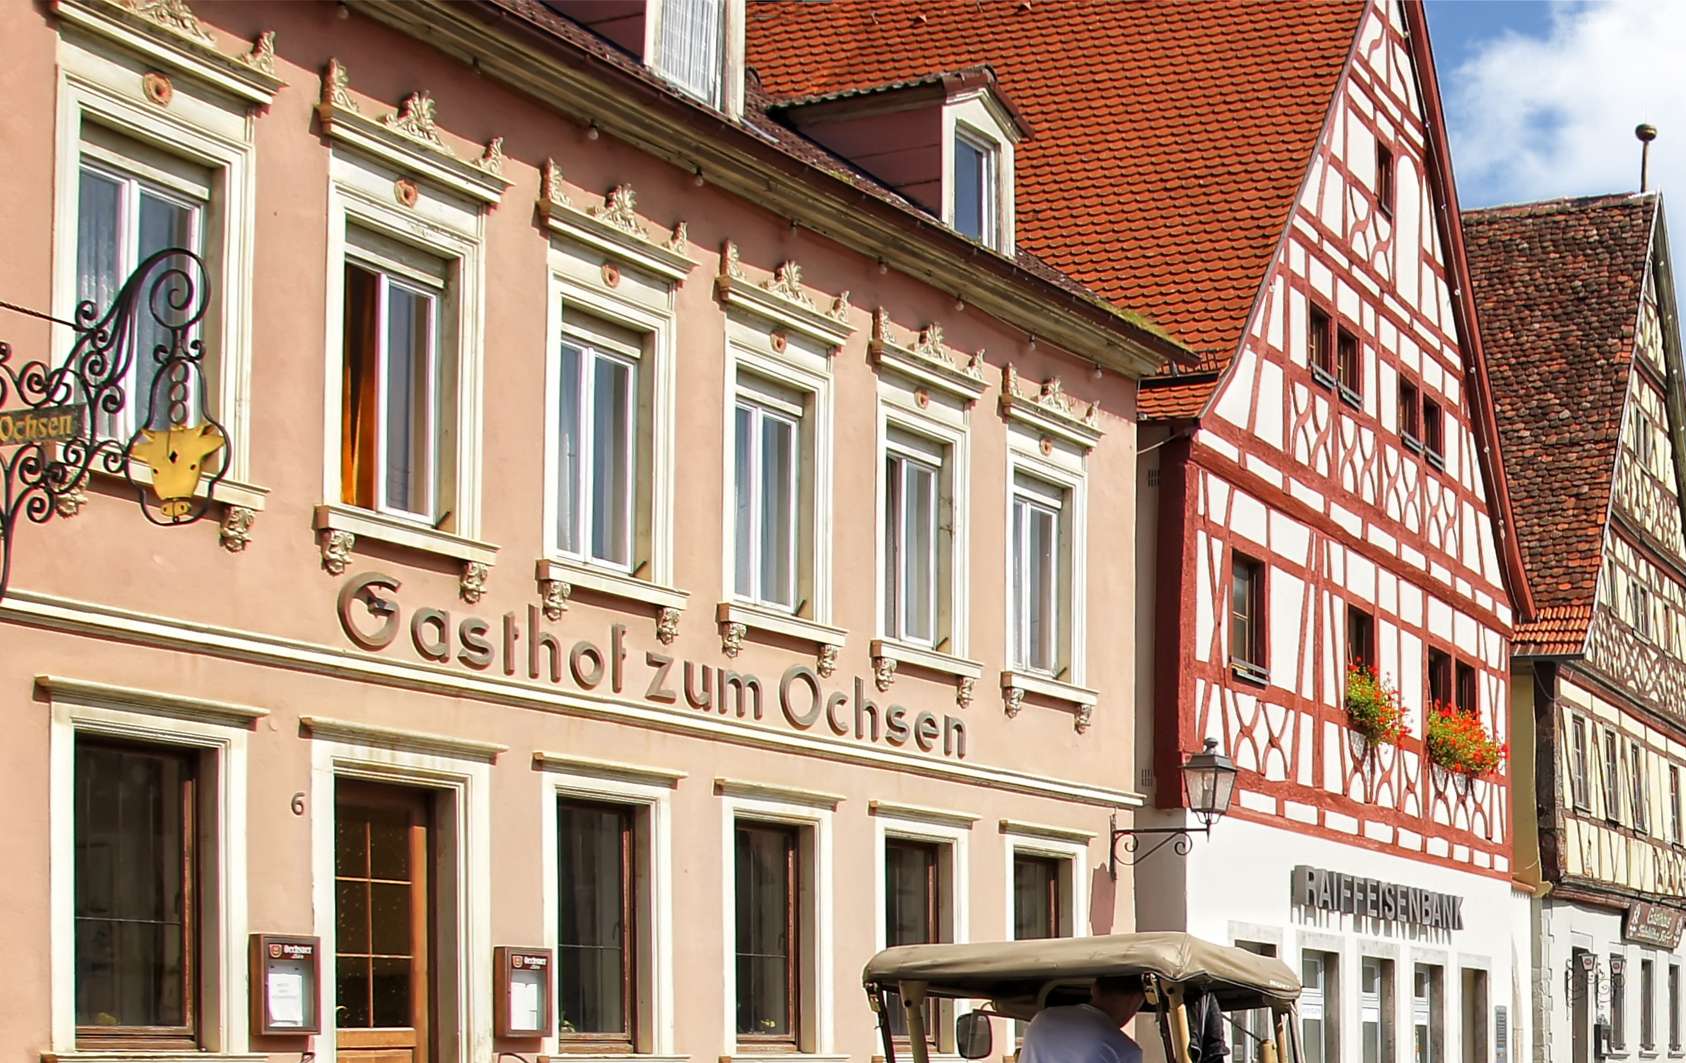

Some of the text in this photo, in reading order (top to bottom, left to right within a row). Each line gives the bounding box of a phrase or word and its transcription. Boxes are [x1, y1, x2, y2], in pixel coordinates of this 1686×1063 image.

[337, 570, 968, 760] Gasthof zum Ochsen
[290, 792, 305, 816] 6
[1293, 865, 1465, 931] RAIFFEISENBANK
